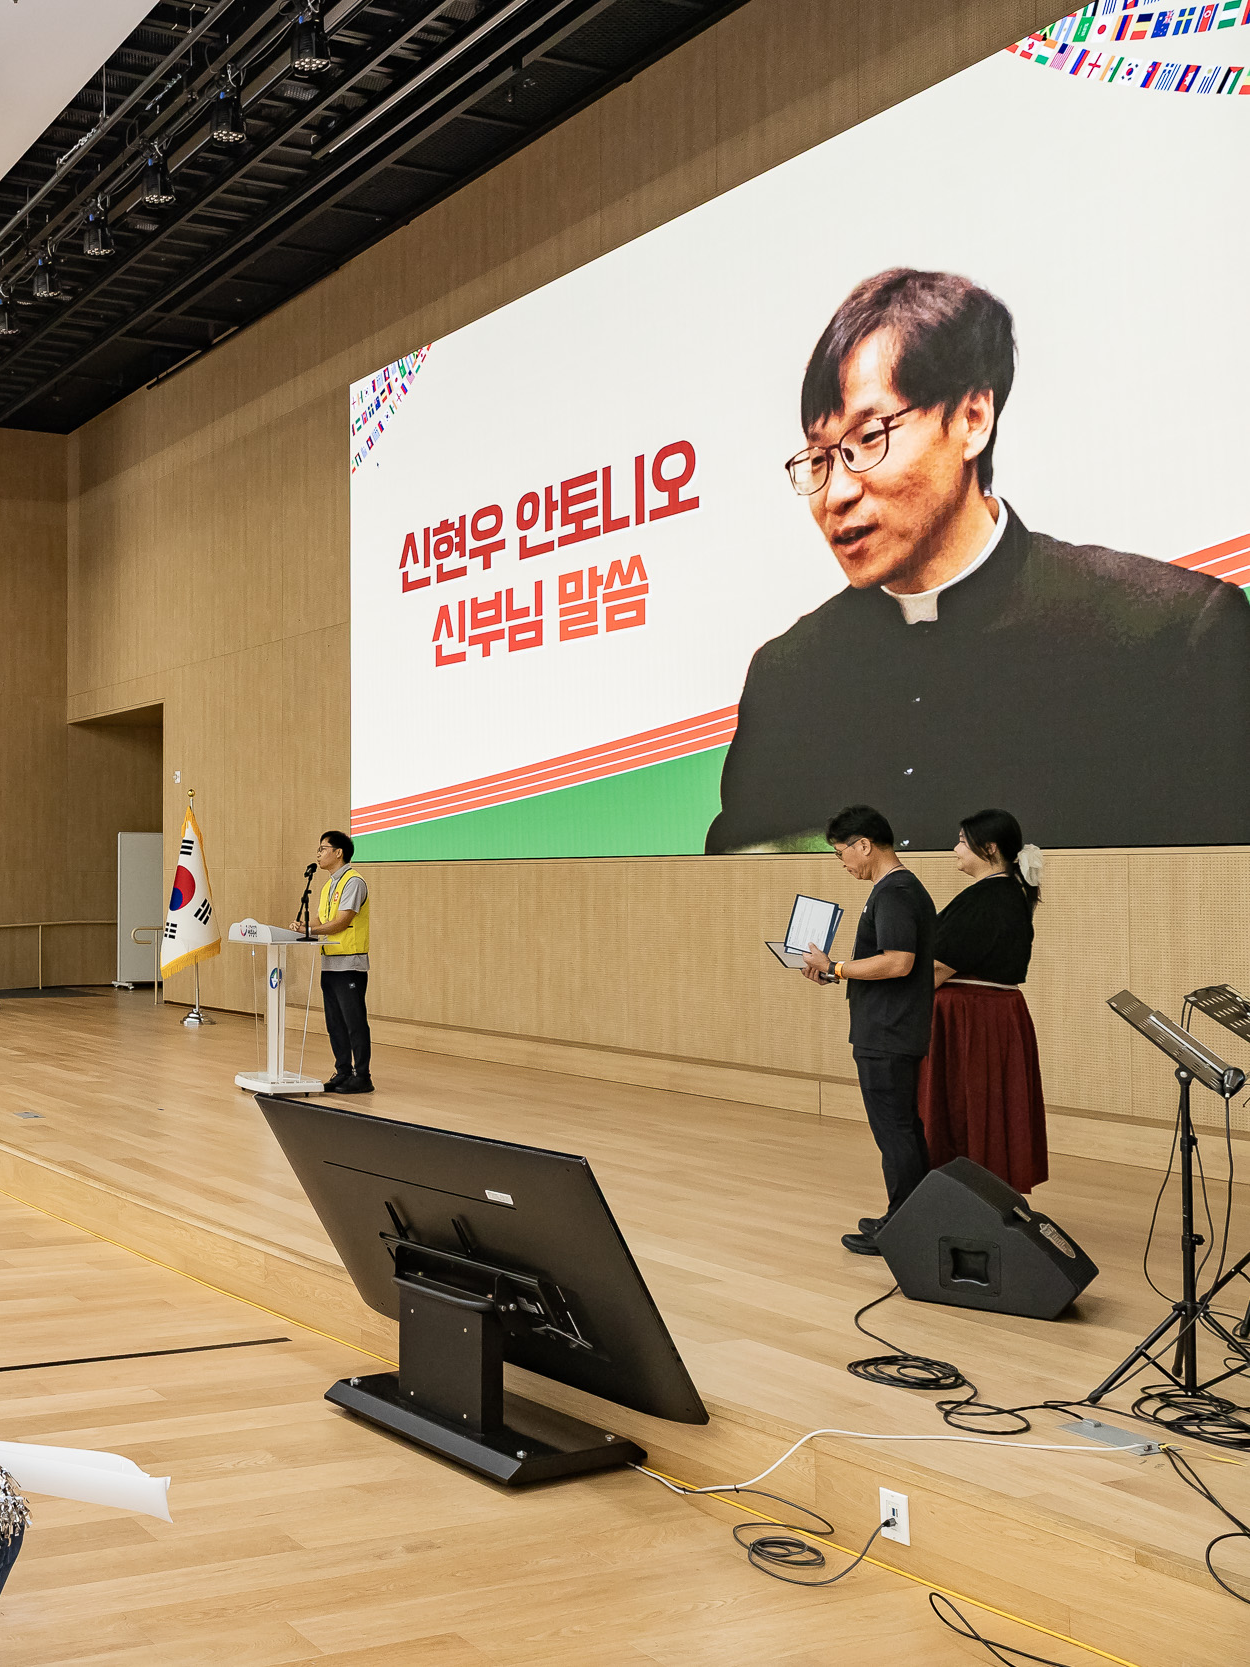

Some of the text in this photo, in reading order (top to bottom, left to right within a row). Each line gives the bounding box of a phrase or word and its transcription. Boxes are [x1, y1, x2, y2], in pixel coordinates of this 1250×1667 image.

[398, 440, 700, 593] 신현우 안토니오
[431, 554, 650, 668] 신부님 말씀
